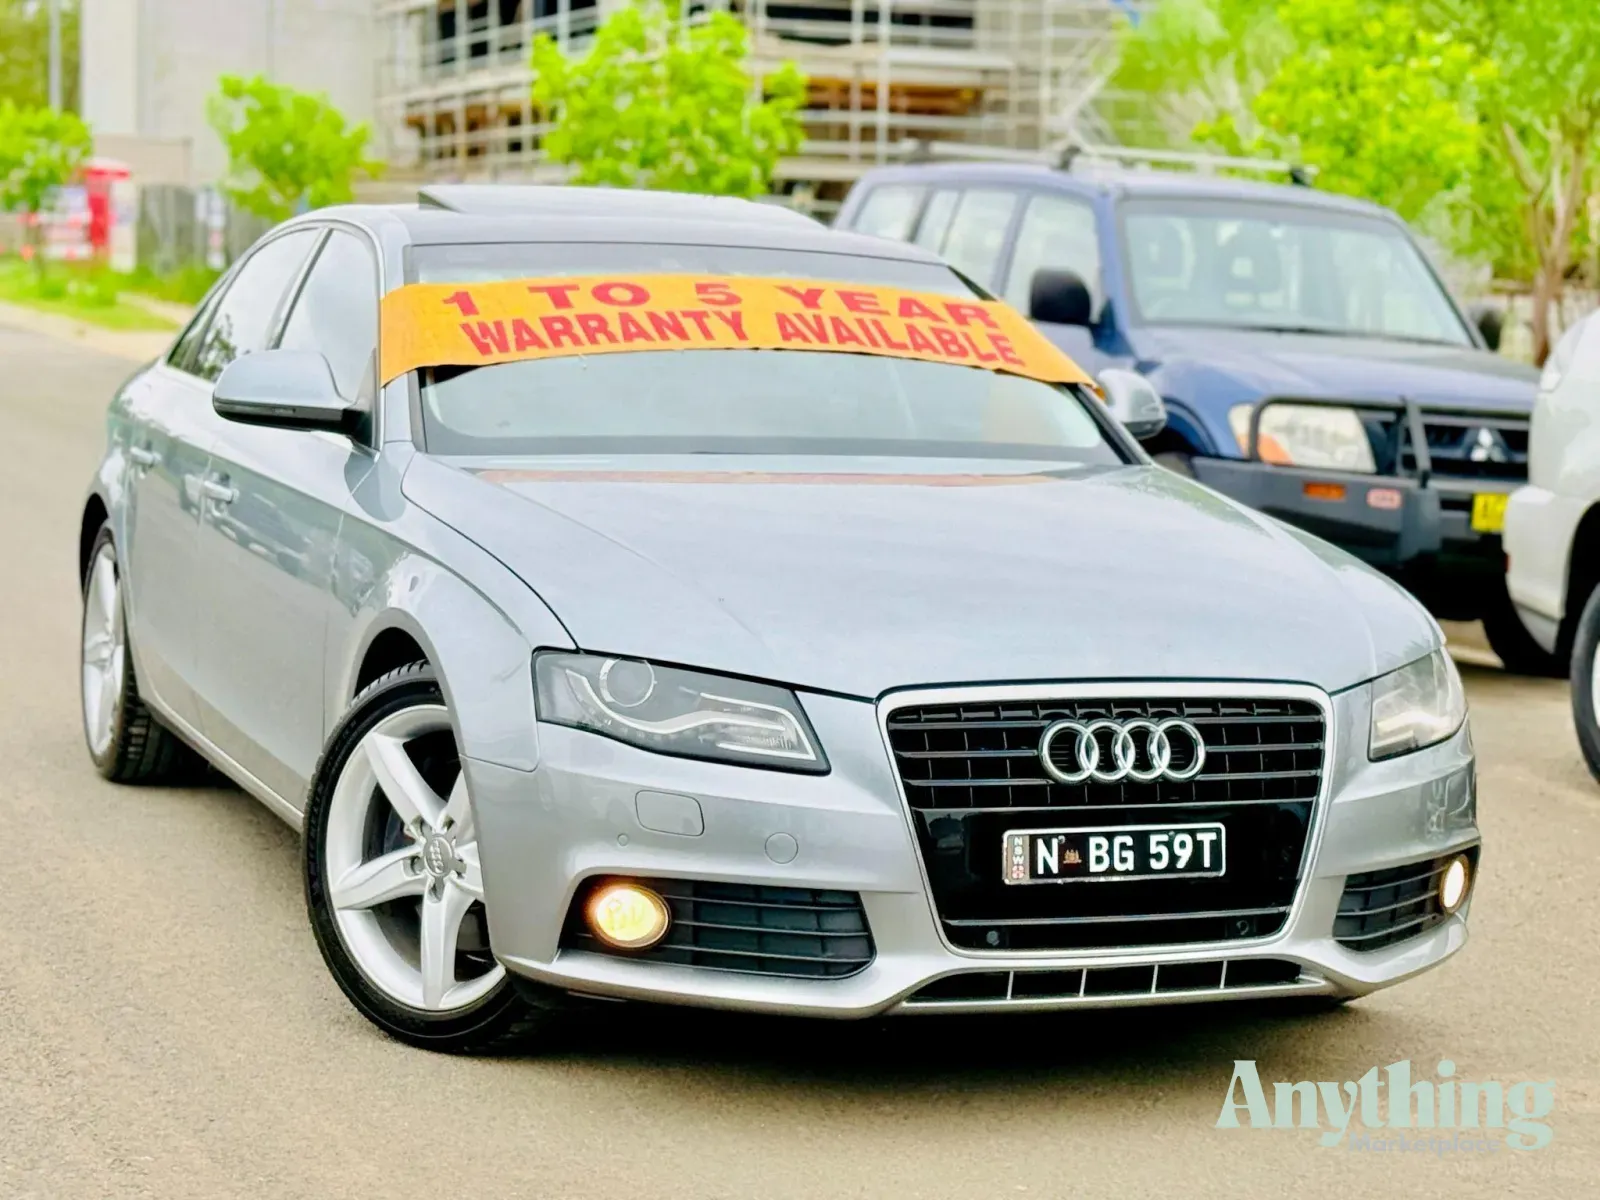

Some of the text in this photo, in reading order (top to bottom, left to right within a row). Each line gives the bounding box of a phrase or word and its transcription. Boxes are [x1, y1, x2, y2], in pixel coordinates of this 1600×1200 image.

[442, 282, 1001, 329] 1 TO 5 YEAR
[460, 310, 1026, 367] WARRANTY AVAILABLE
[1037, 832, 1217, 874] N BG 59T
